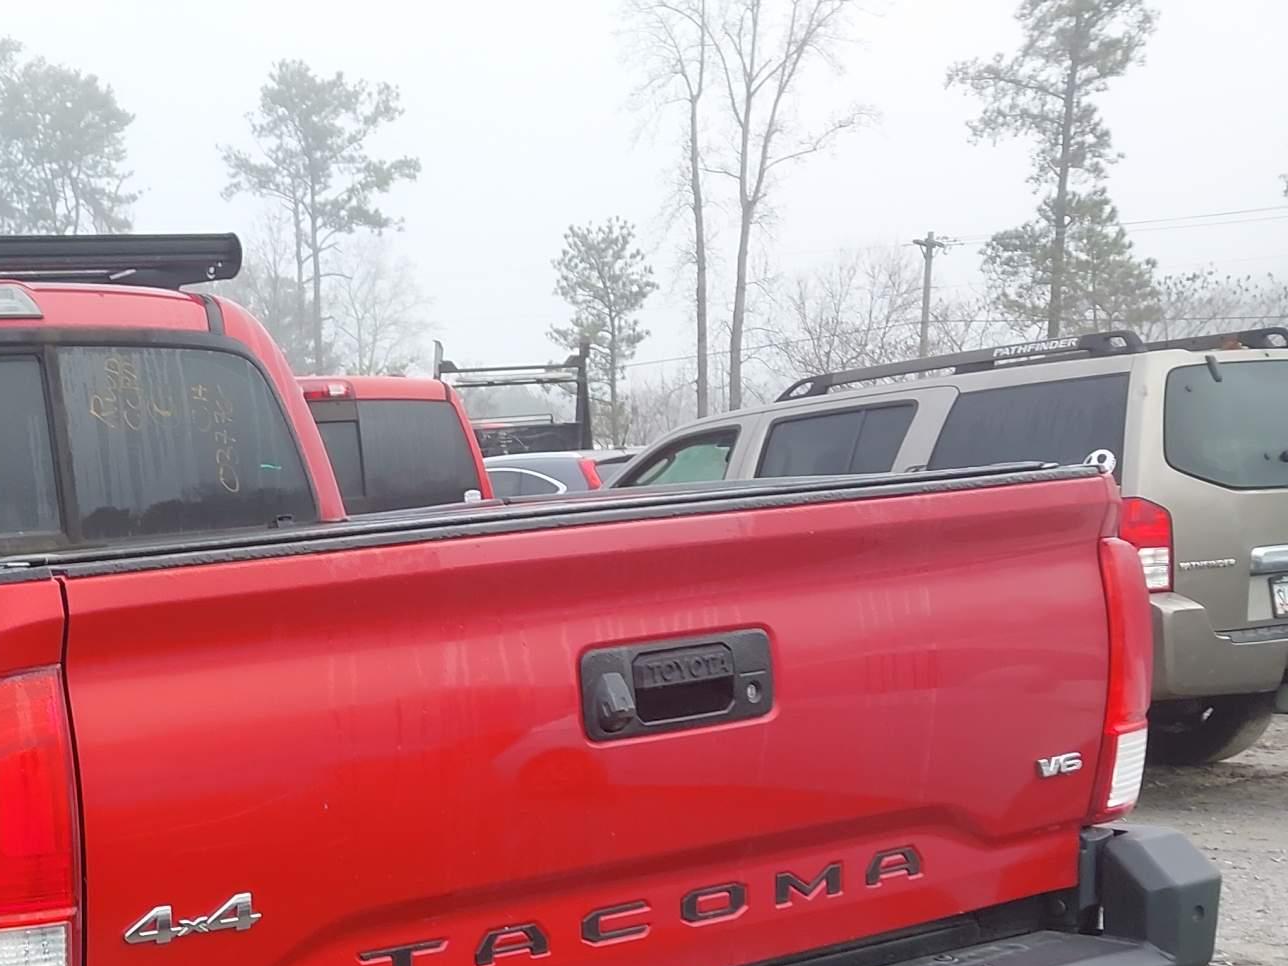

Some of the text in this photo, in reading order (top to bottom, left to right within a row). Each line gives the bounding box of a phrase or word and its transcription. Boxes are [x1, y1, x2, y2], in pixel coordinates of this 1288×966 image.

[993, 338, 1078, 357] PATHFINDER
[646, 653, 729, 683] TOYOTA
[1037, 752, 1083, 777] V6
